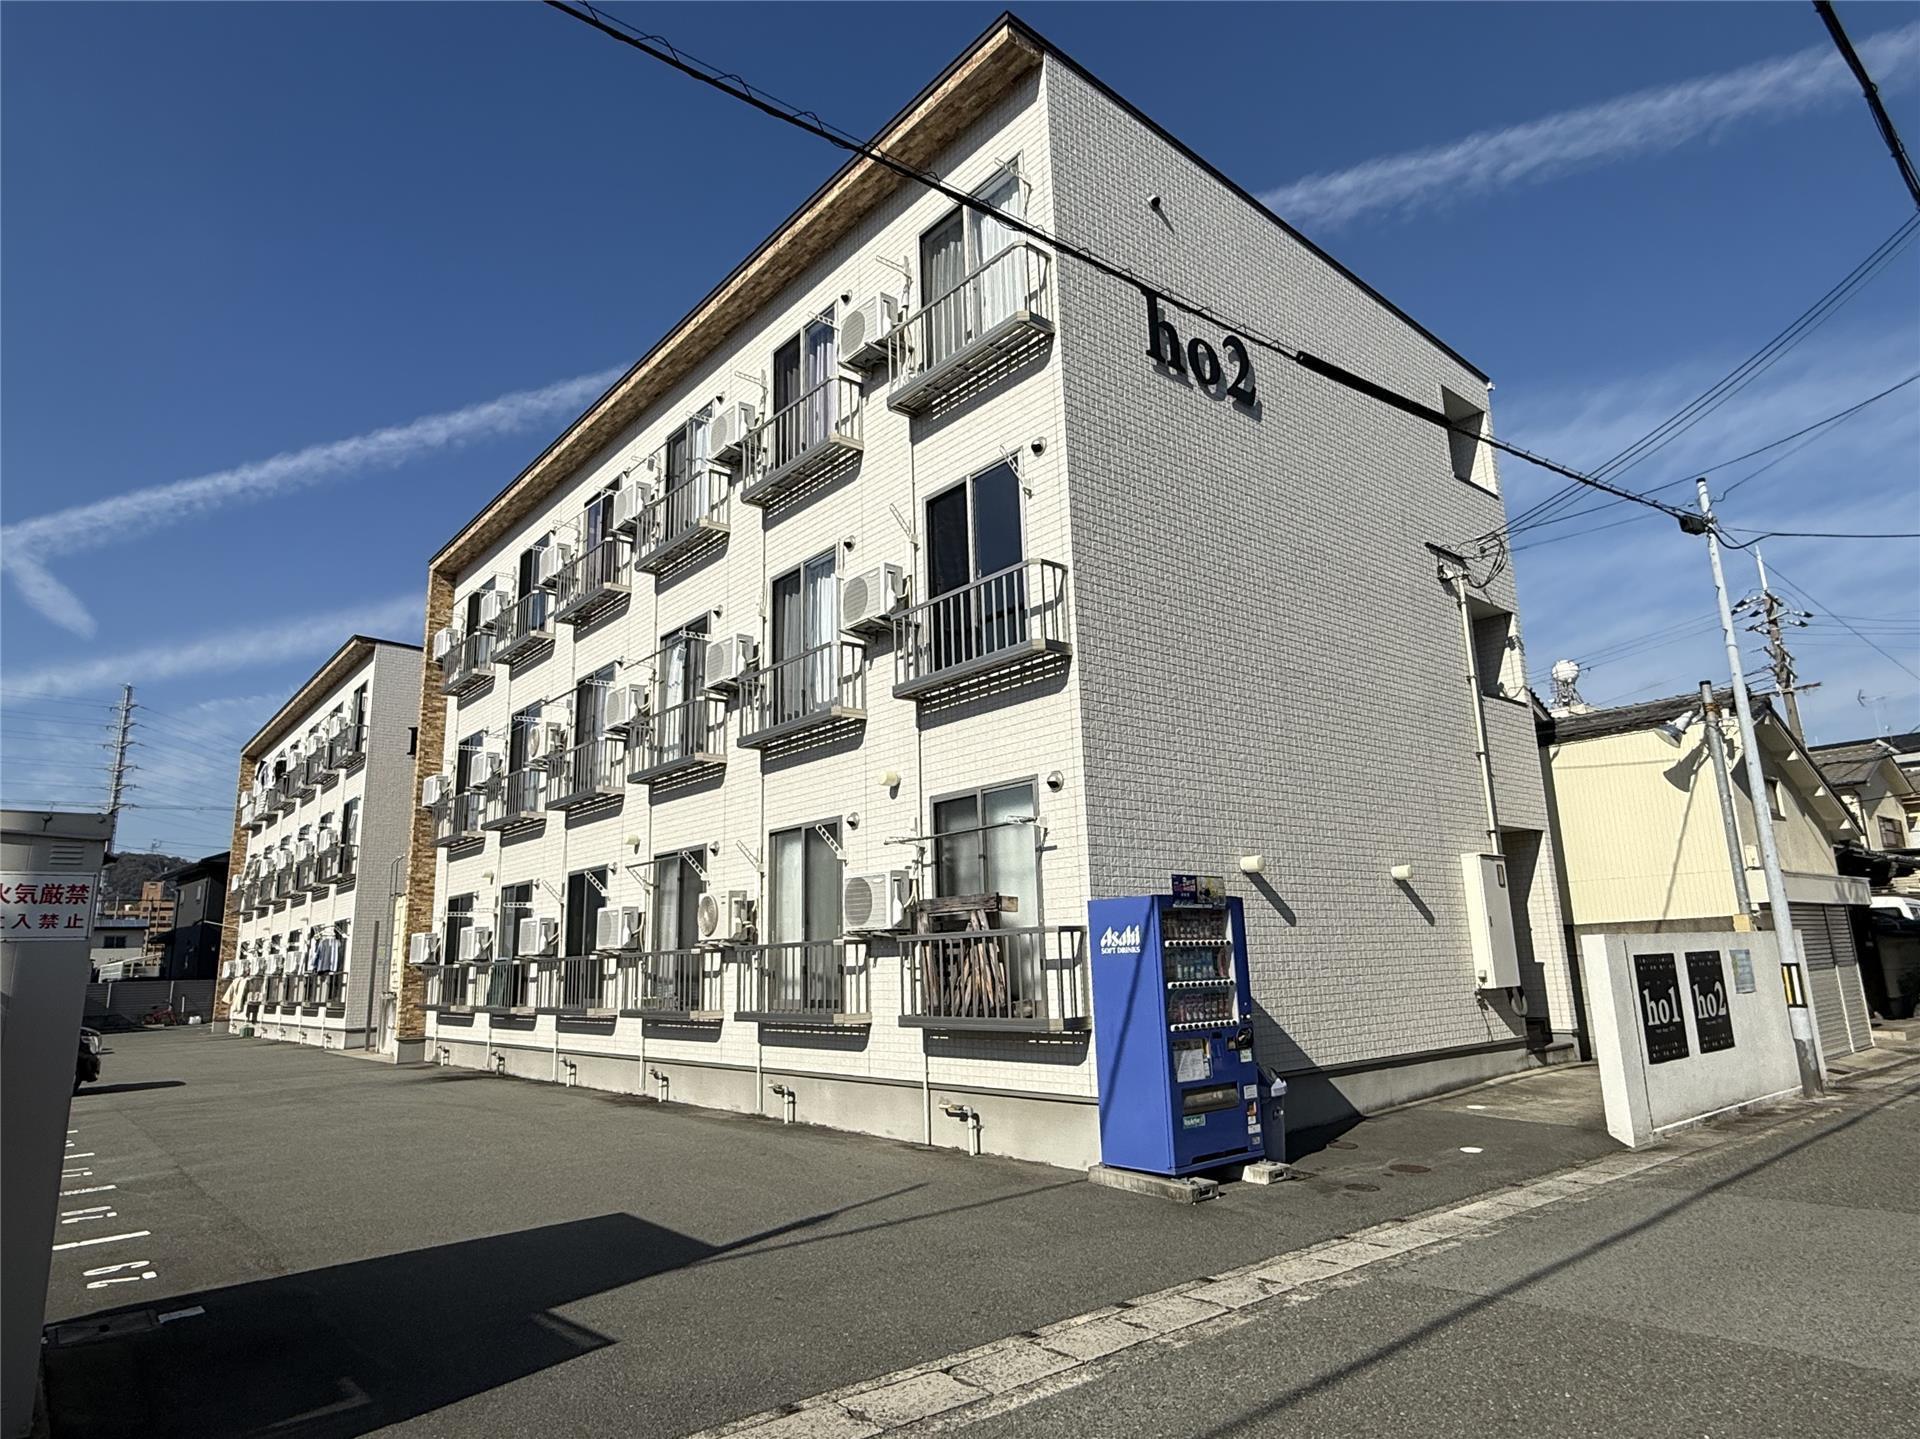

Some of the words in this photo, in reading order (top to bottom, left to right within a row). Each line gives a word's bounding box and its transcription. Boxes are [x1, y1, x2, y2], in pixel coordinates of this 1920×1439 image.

[1141, 287, 1256, 407] ho2
[0, 913, 84, 929] 入禁止
[1100, 925, 1140, 947] Asahi
[1101, 947, 1116, 955] SOFT
[1117, 946, 1141, 954] DRINKS
[1642, 986, 1681, 1026] ho1
[1693, 981, 1727, 1019] ho2
